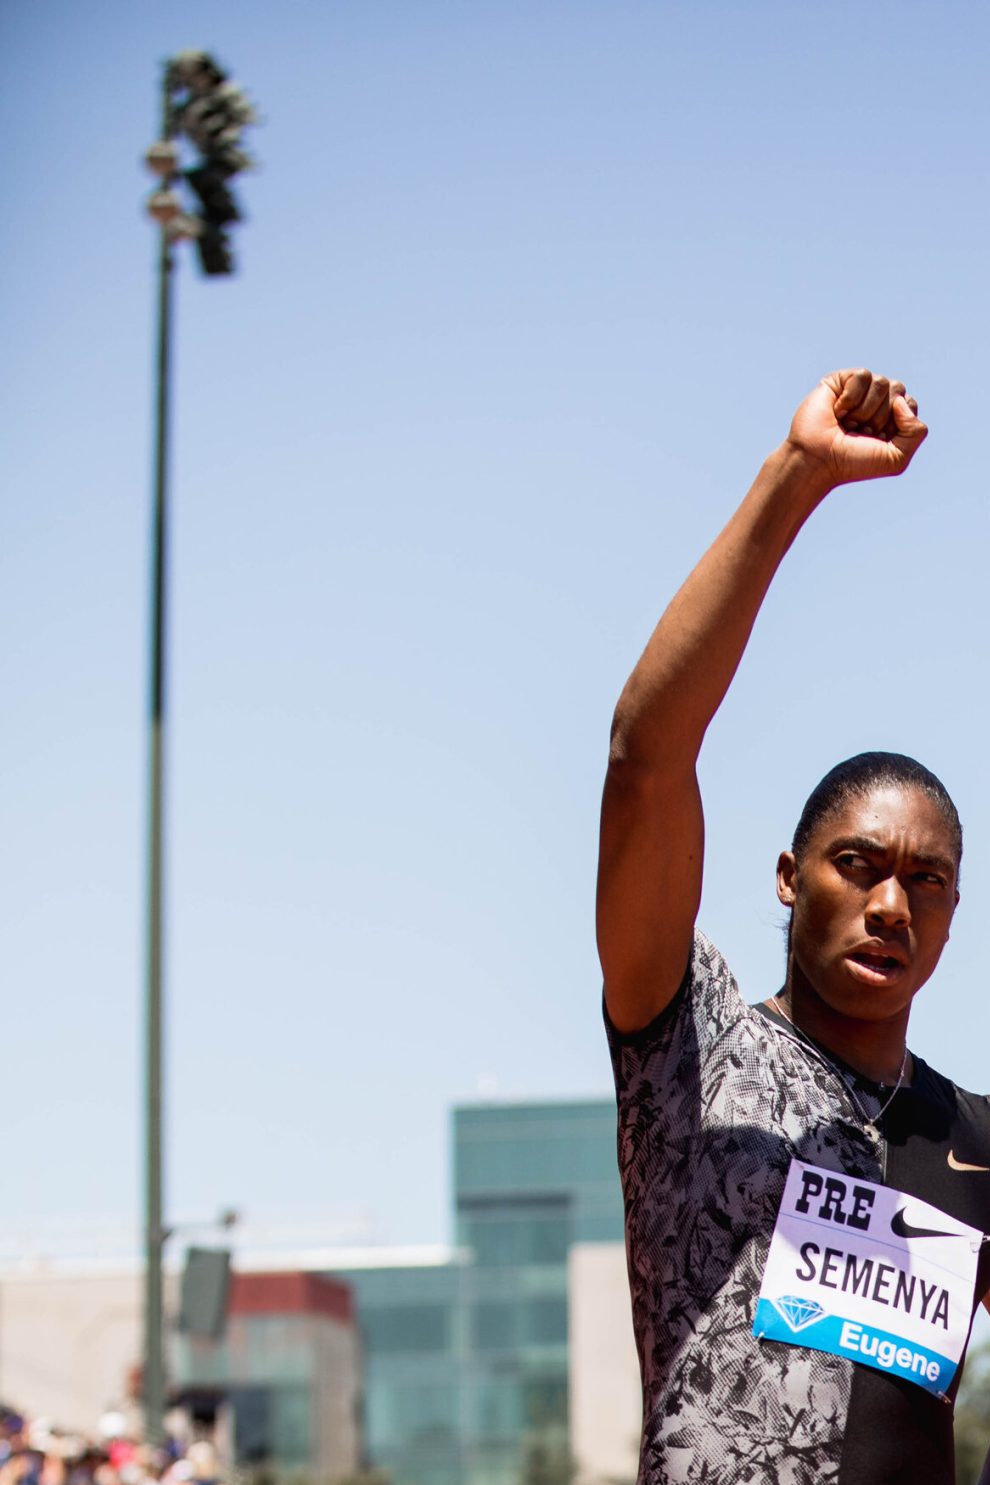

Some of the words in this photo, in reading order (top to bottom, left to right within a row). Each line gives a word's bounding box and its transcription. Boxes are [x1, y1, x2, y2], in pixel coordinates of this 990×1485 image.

[795, 1171, 876, 1231] PRE
[796, 1242, 950, 1331] SEMENYA
[838, 1321, 941, 1382] Eugene
